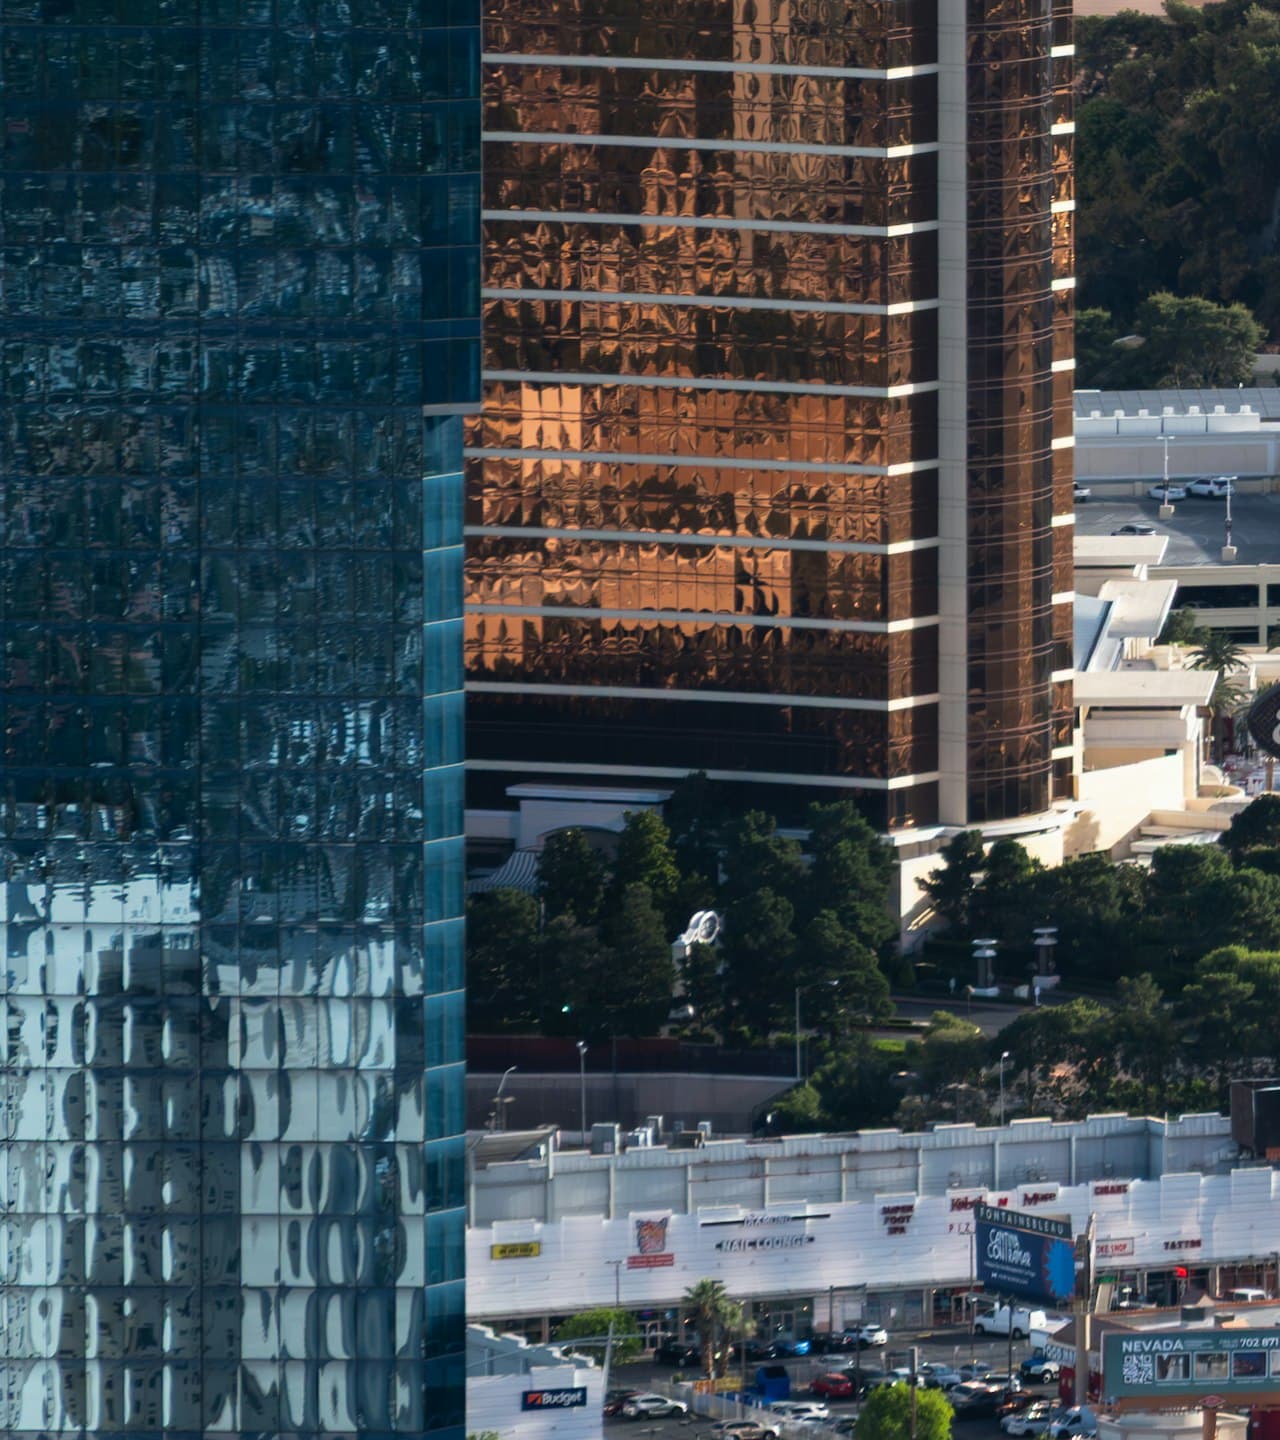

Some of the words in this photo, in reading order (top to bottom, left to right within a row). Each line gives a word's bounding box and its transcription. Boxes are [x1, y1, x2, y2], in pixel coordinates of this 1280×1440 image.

[882, 1205, 914, 1216] SUPER
[884, 1216, 911, 1225] FOOT
[980, 1207, 1064, 1235] FONTAINEBLEAU
[1122, 1339, 1184, 1352] NEVADA
[1240, 1338, 1260, 1348] 702
[1262, 1337, 1279, 1347] 871
[540, 1392, 583, 1406] Budget
